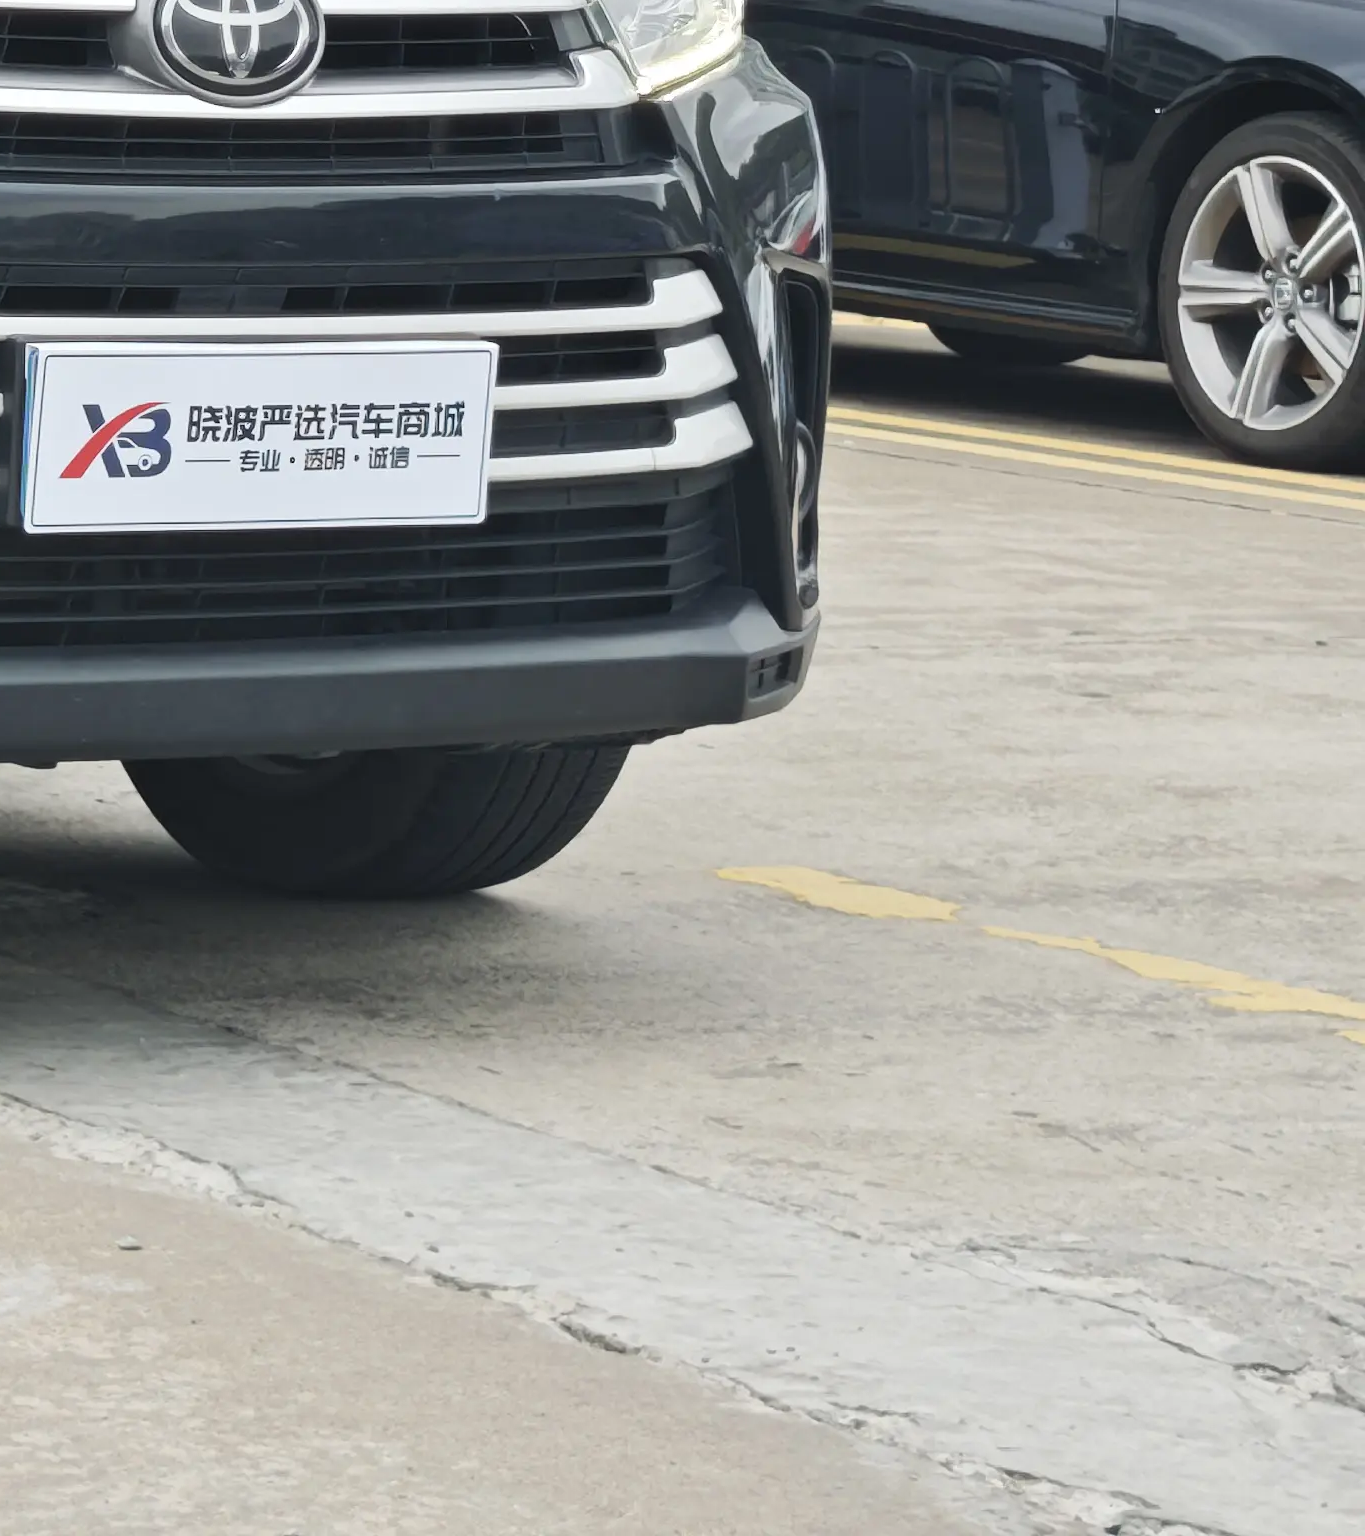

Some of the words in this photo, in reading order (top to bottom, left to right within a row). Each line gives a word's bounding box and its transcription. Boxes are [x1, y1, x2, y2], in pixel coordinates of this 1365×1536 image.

[187, 400, 465, 442] 晓波严选汽车商城
